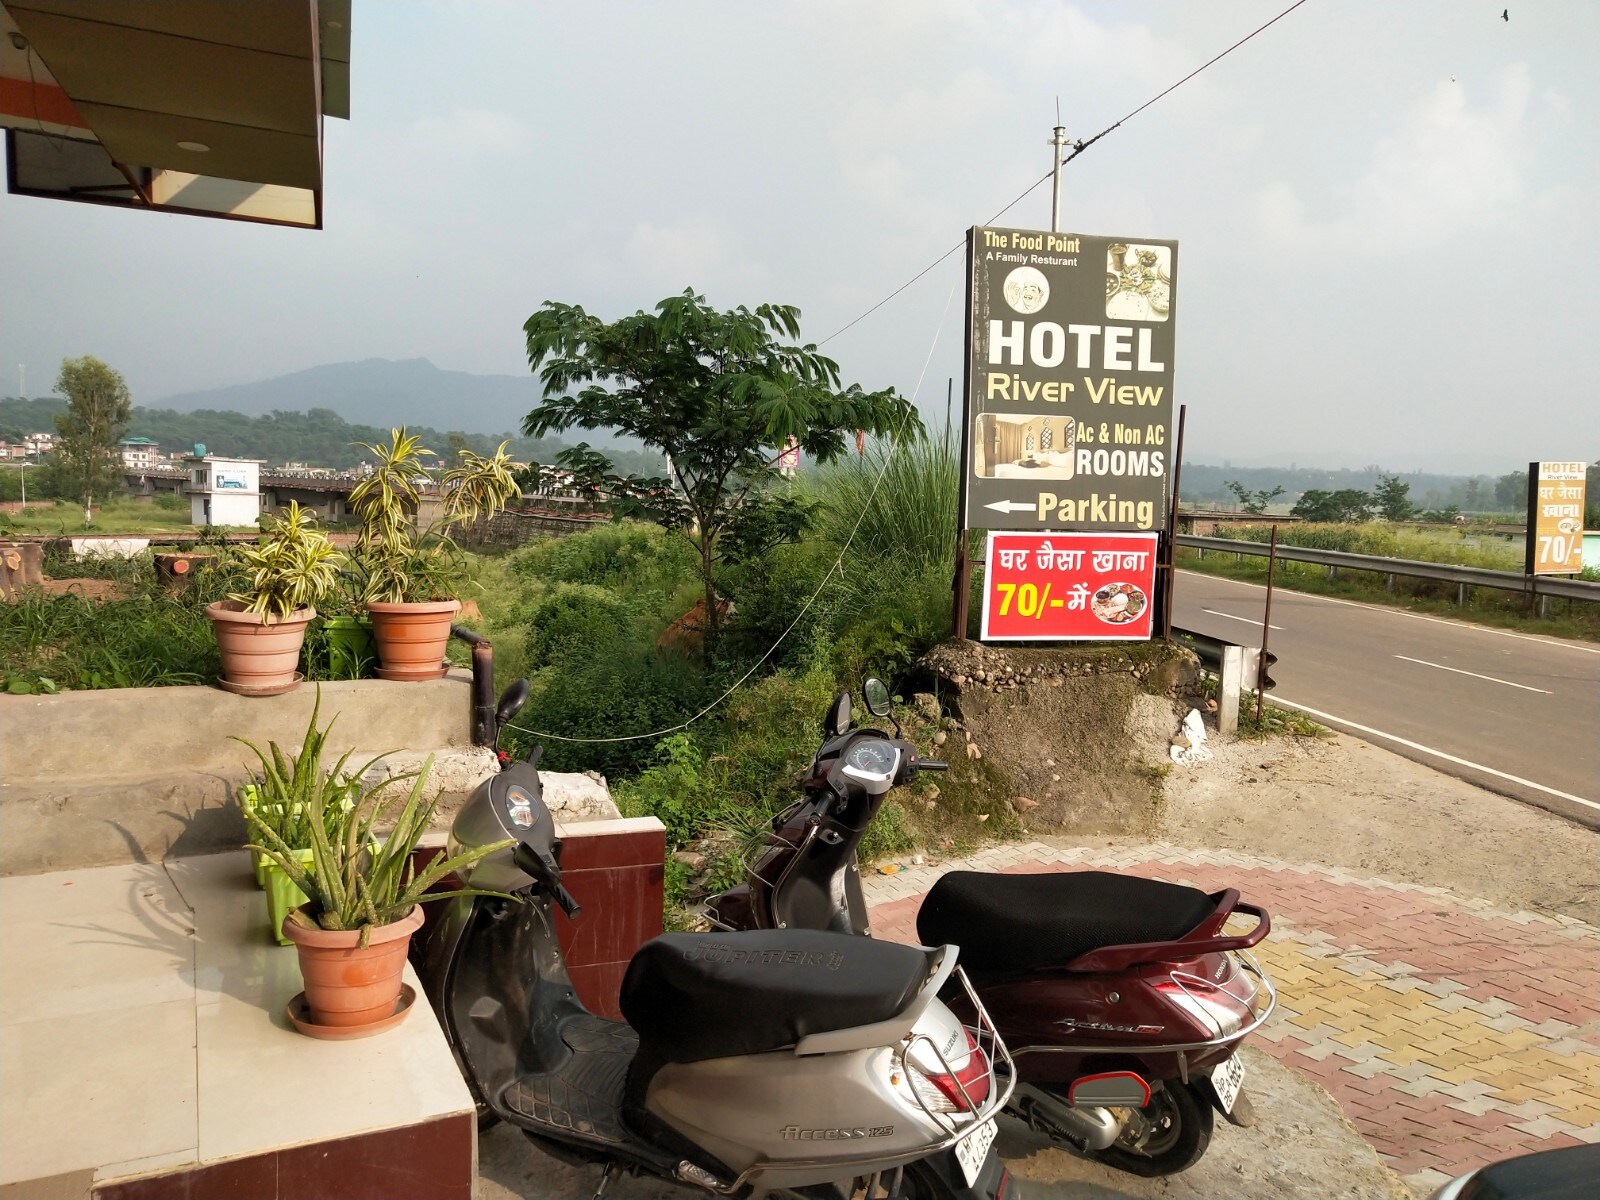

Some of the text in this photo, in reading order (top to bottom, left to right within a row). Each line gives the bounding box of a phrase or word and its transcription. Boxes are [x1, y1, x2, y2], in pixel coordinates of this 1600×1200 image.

[984, 230, 1081, 253] The Food Point
[986, 252, 1078, 267] A Family Resturant
[988, 319, 1165, 372] HOTEL
[987, 372, 1164, 406] River View
[1076, 421, 1165, 446] Ac & Non AC
[1076, 449, 1164, 477] ROOMS
[1542, 463, 1584, 473] HOTEL
[1539, 482, 1584, 500] घर जैसा
[1038, 492, 1153, 529] Parking
[1542, 504, 1580, 518] खाना
[998, 541, 1150, 573] घर जैसा खाना
[1539, 535, 1582, 566] 70/-
[997, 581, 1091, 620] 70/- में
[943, 1030, 959, 1056] SUZUKI
[868, 1125, 895, 1138] 125
